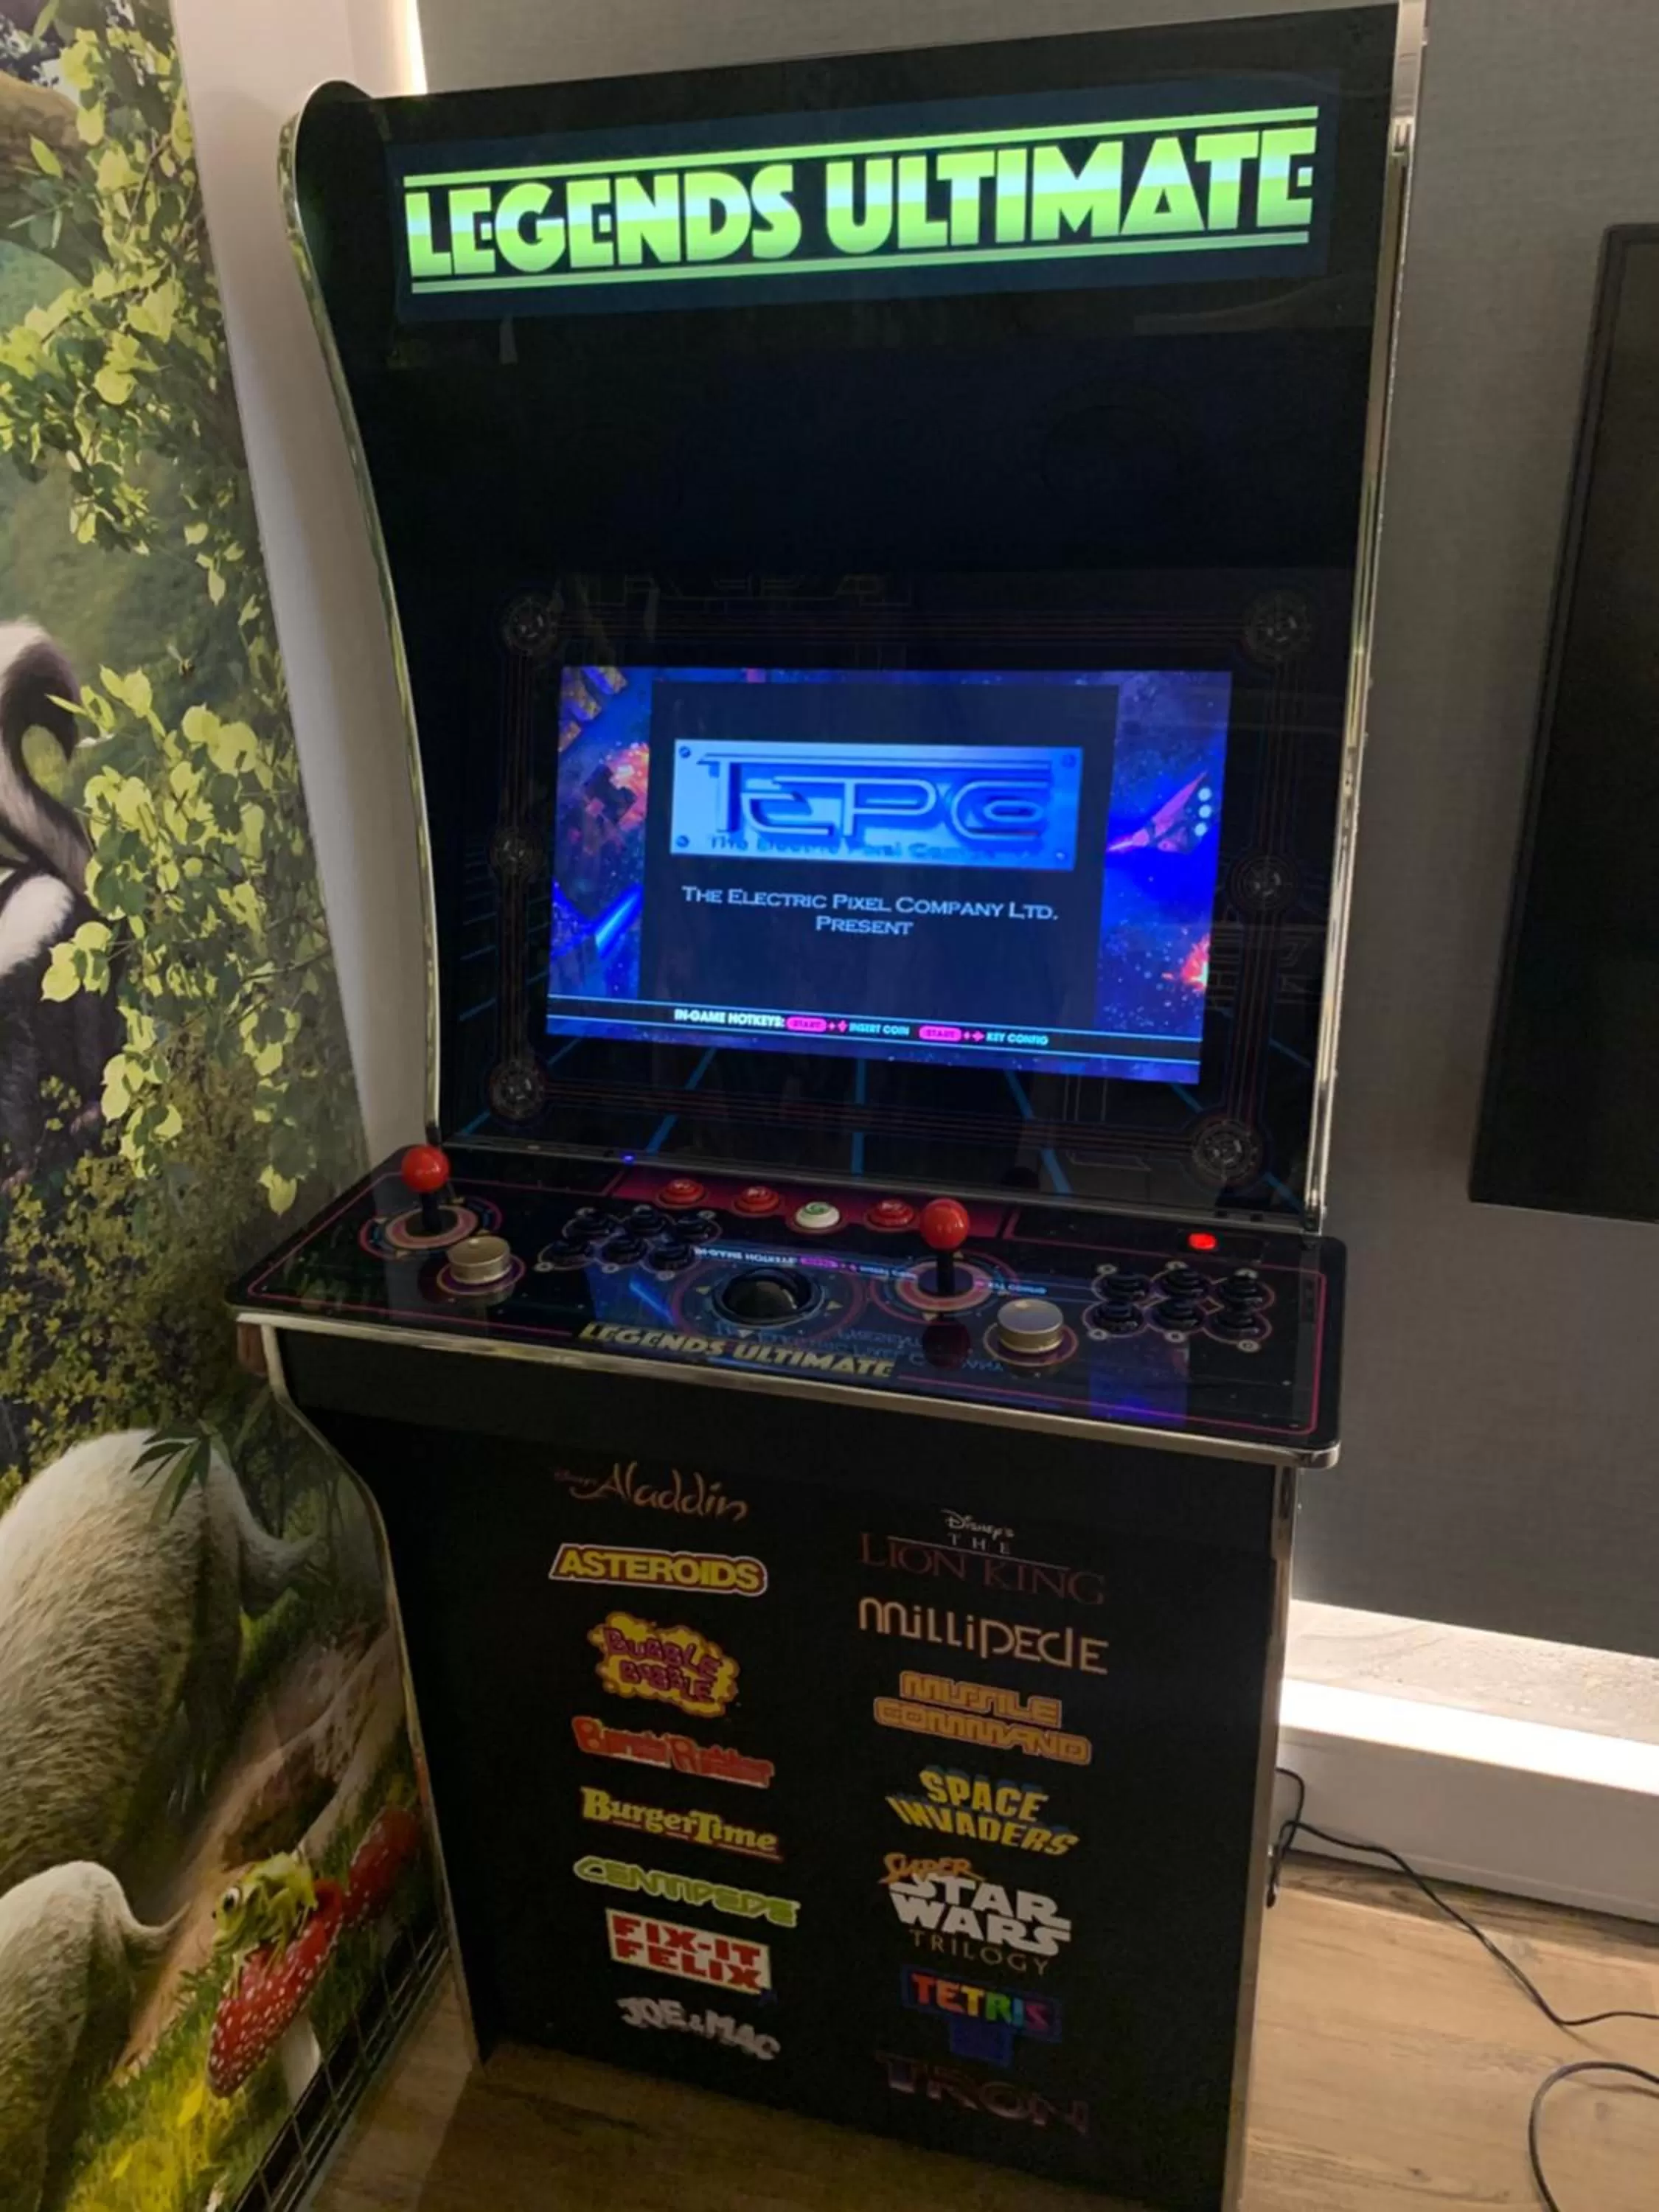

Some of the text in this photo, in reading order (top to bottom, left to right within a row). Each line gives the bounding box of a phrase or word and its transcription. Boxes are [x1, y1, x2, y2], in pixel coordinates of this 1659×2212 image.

[406, 126, 1317, 278] LEGENDS ULTIMATE
[681, 885, 1059, 920] THE ELECTRIC PIXEL COMPANY LTD.
[815, 914, 914, 935] PRESENT
[674, 1008, 726, 1024] IN-GAME
[578, 1322, 726, 1357] LEGENDS
[733, 1343, 895, 1378] ULTIMATE
[569, 1461, 748, 1521] Aladdin
[558, 1549, 760, 1591] ASTEROIDS
[860, 1532, 1105, 1605] LION KING
[919, 1766, 1050, 1823] SPACE
[886, 1794, 1082, 1857] INVADERS
[574, 1856, 801, 1928] CENTIPEDE
[888, 1873, 1071, 1932] STAR
[612, 1915, 761, 1966] FIX-IT
[889, 1893, 1071, 1957] WARS
[908, 1929, 1050, 1976] TRILOGY
[614, 1938, 762, 1990] FELIX
[616, 1997, 685, 2030] JOE
[705, 2010, 781, 2060] MAC
[911, 1972, 1049, 2032] TETRIS
